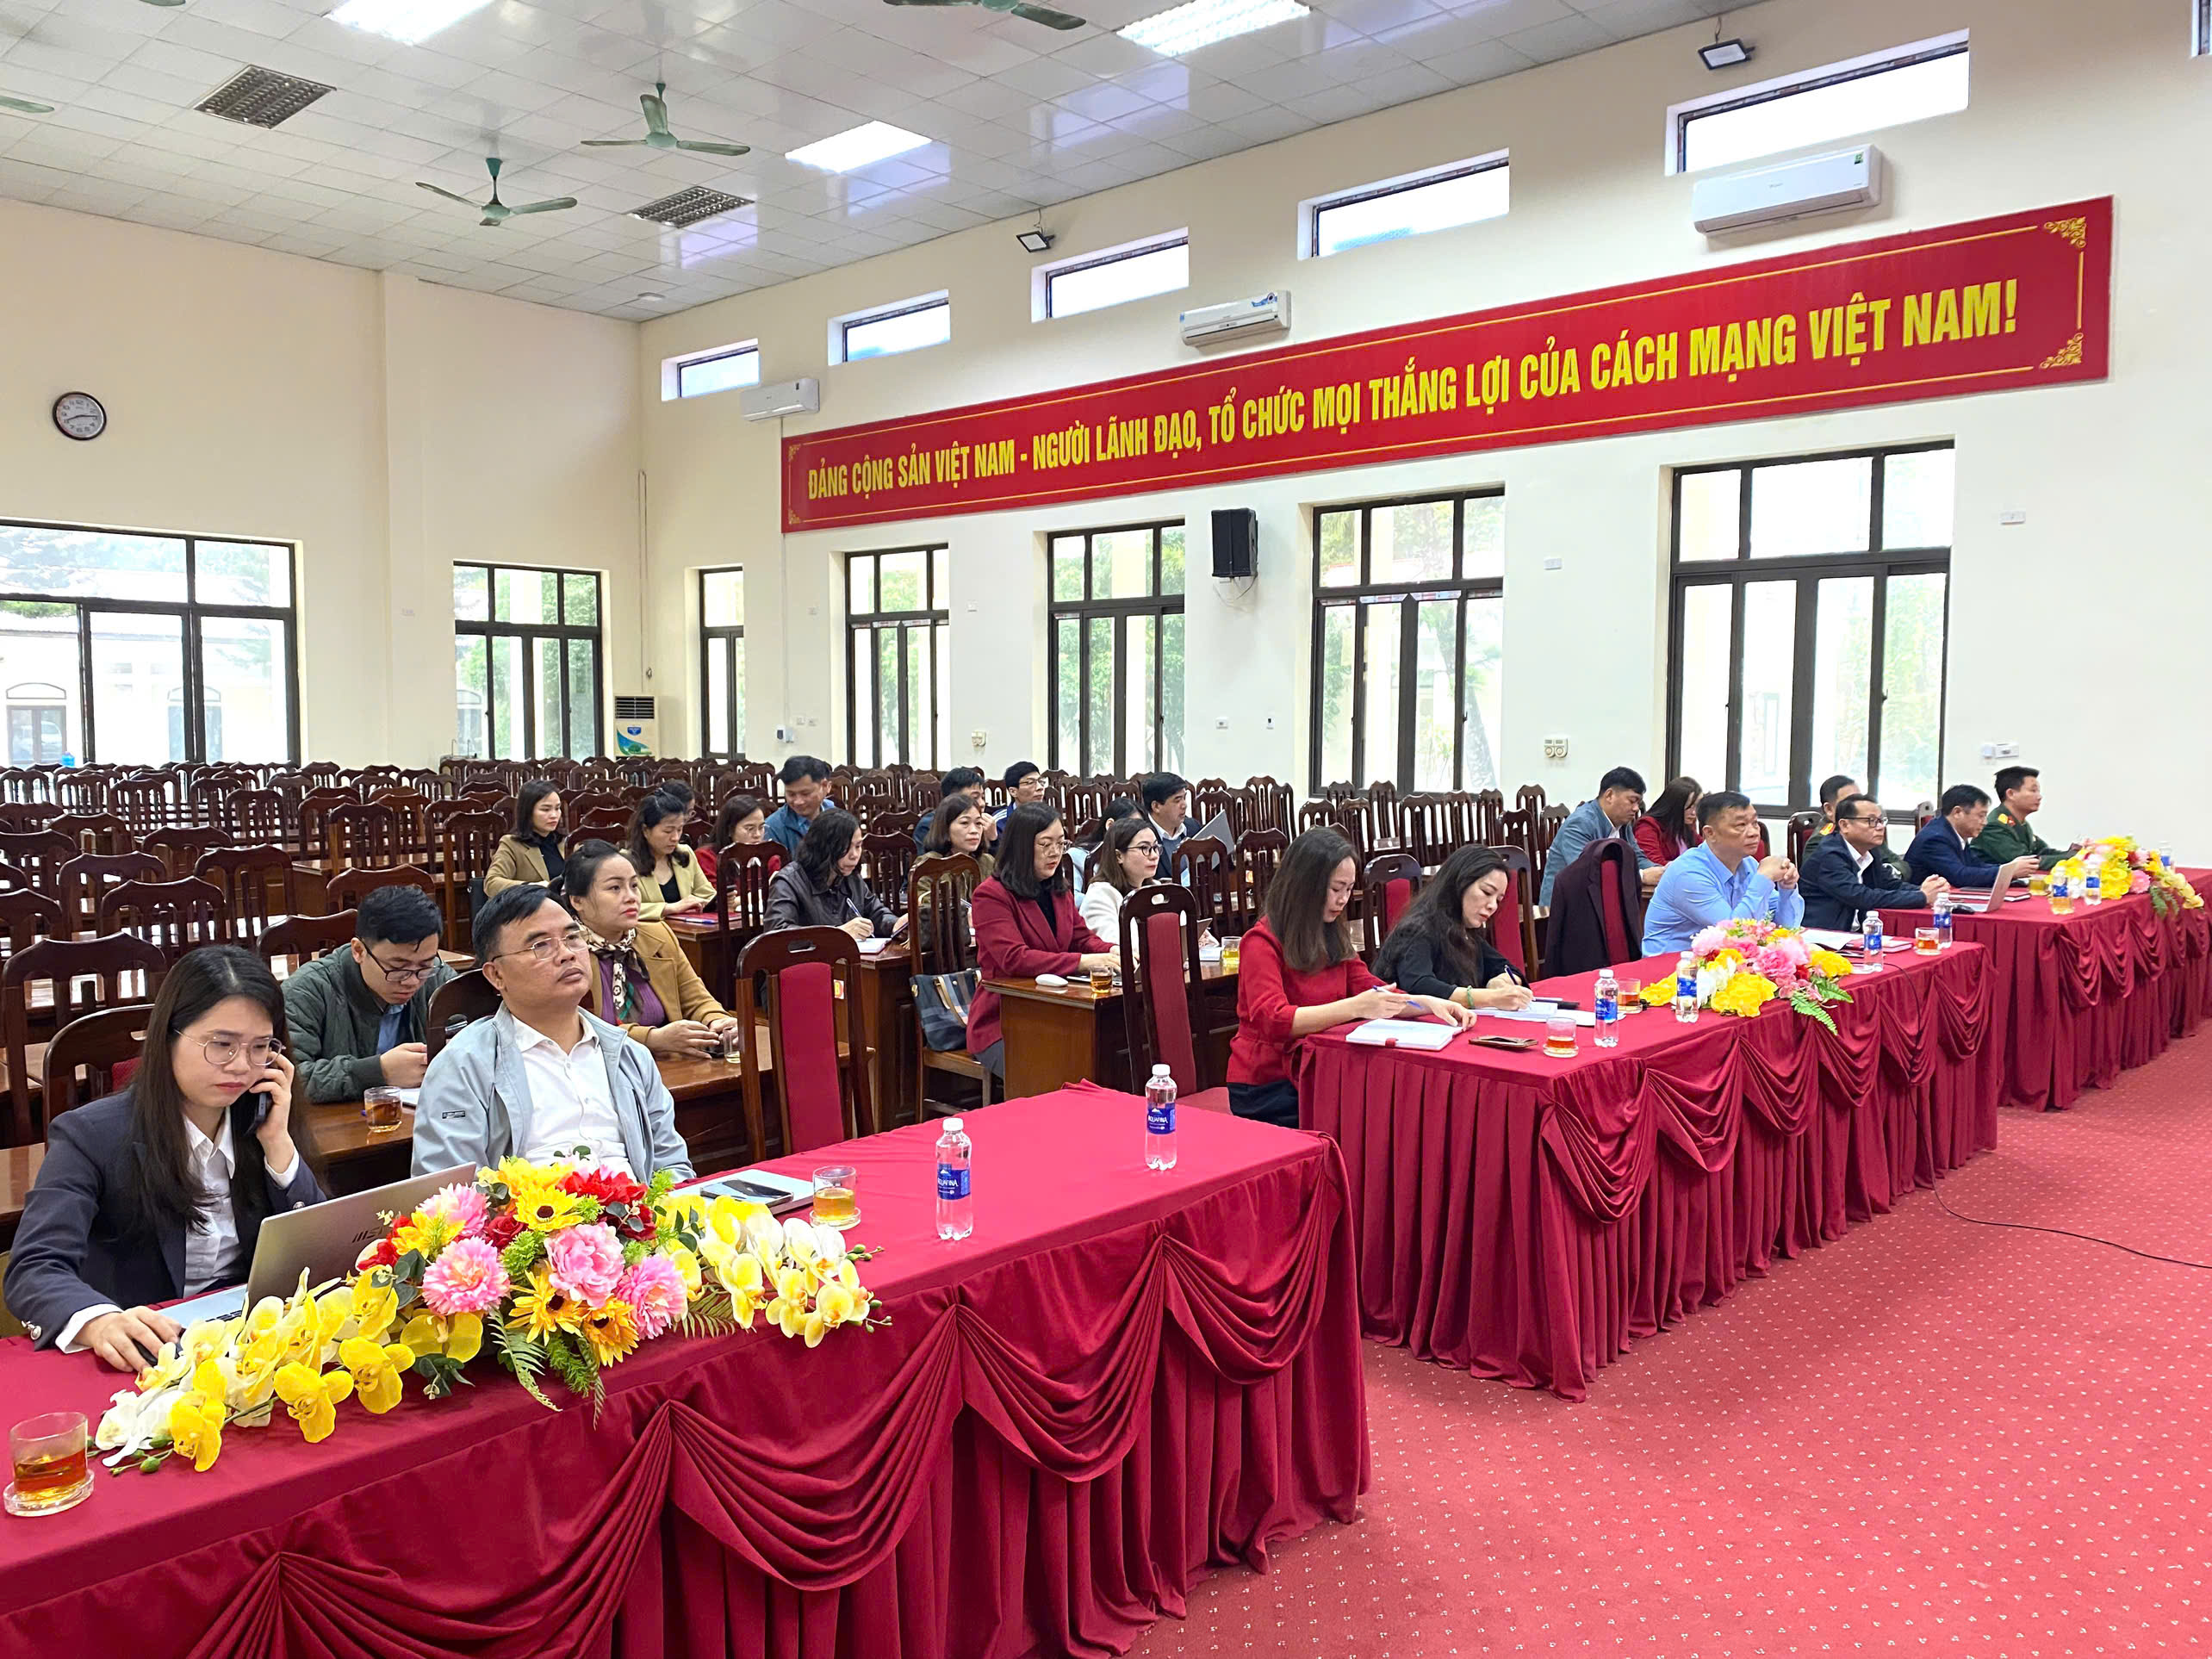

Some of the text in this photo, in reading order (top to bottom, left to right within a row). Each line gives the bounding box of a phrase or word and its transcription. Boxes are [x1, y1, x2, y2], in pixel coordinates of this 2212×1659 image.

[808, 457, 848, 500] ĐẢNG
[851, 454, 893, 498] CỘNG
[898, 442, 931, 488] SẢN
[935, 441, 970, 489] VIỆT
[974, 439, 1015, 478] NAM
[1033, 419, 1090, 470] NGƯỜI
[1096, 415, 1148, 462] LÃNH
[1153, 409, 1202, 458] ĐẠO,
[1208, 386, 1237, 444] TỔ
[1242, 385, 1305, 439] CHỨC
[1313, 382, 1361, 435] MỌI
[1368, 356, 1457, 421] THẮNG
[1466, 354, 1510, 415] LỢI
[1519, 335, 1581, 401] CỦA
[1590, 329, 1678, 390] CÁCH
[1689, 314, 1797, 383] MẠNG
[1808, 291, 1892, 367] VIỆT
[1903, 278, 2017, 347] NAM!
[937, 1177, 959, 1186] QUAFINA
